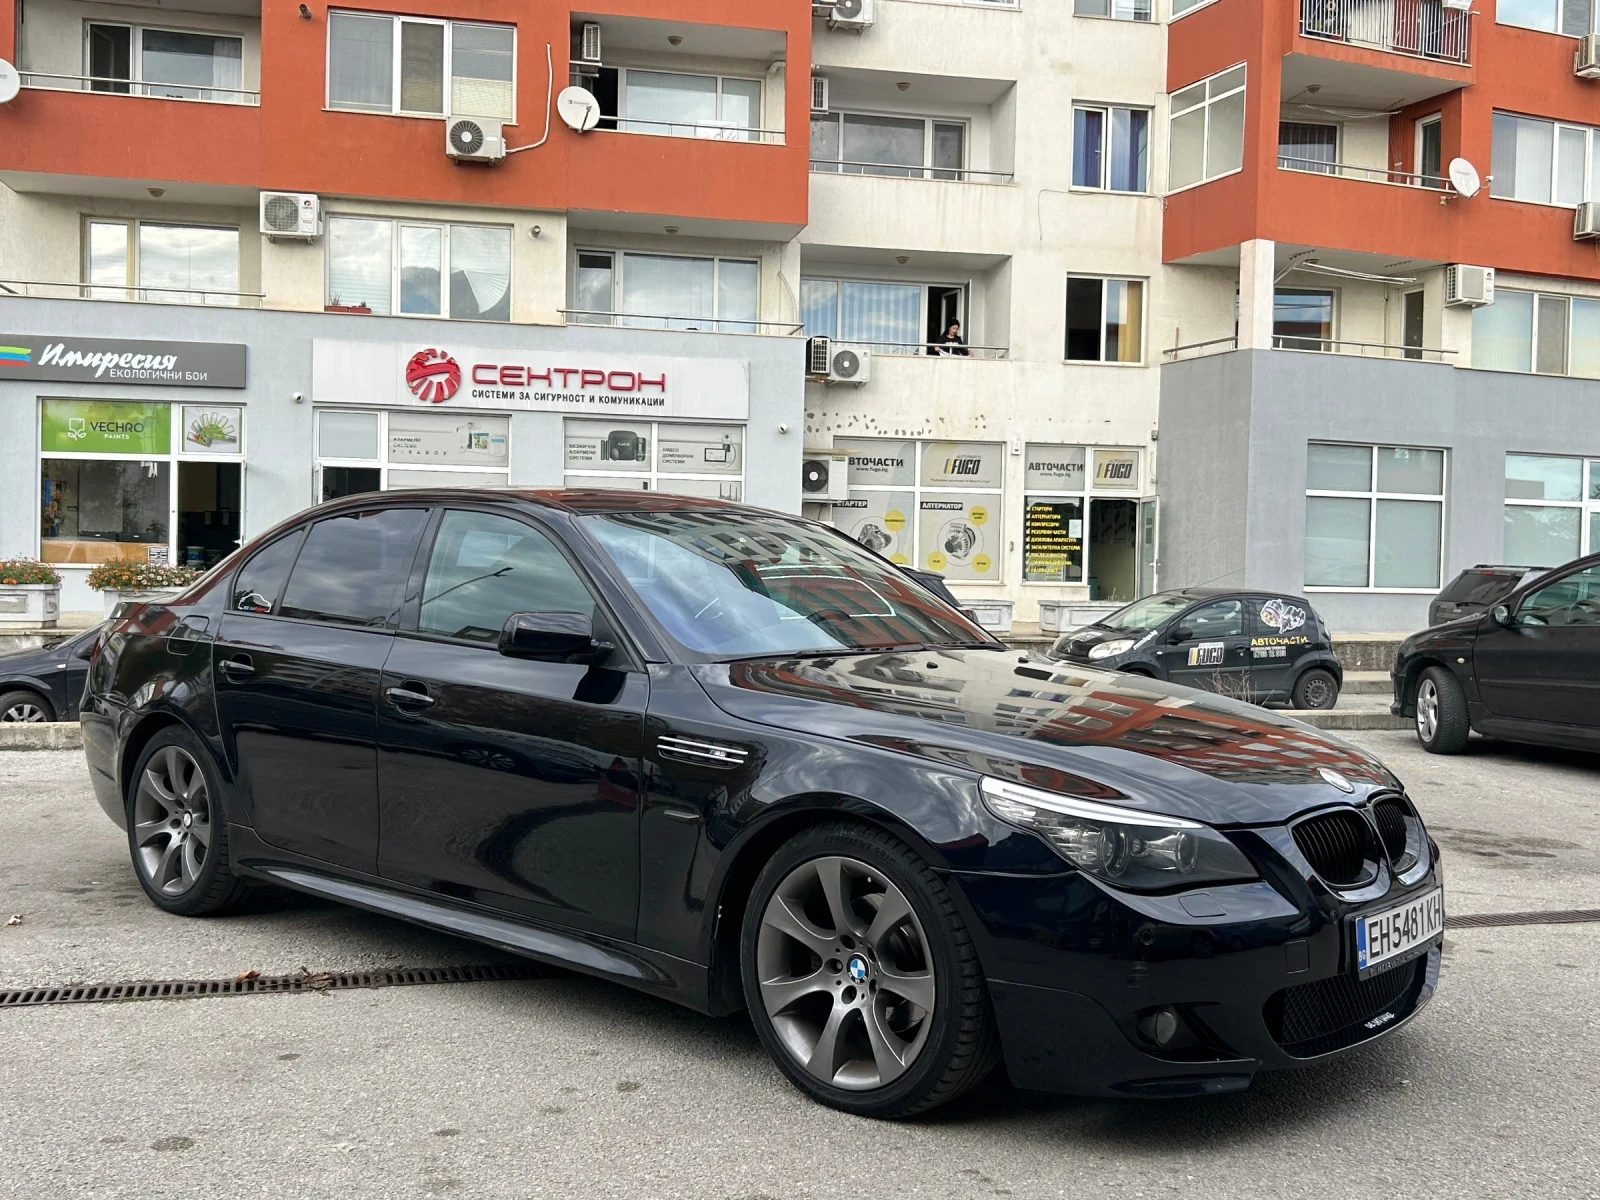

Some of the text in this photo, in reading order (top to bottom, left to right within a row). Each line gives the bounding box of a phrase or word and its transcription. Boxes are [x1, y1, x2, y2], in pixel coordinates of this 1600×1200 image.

[110, 369, 208, 381] ЕКОЛОГИЧНИ БОИ
[472, 363, 666, 392] СЕКТРОН
[472, 389, 665, 407] СИСТЕМИ ЗА СИГУРНОСТ И КОМУНИКАЦИИ
[90, 421, 145, 433] VECHRO
[848, 456, 904, 467] ВТОЧАСТИ
[950, 459, 981, 475] FUGO
[1028, 462, 1084, 472] АВТОЧАСТИ
[1103, 463, 1133, 479] FUGO
[922, 502, 963, 510] АЛТЕРНАТОР
[1250, 635, 1309, 646] АВТОЧАСТИ
